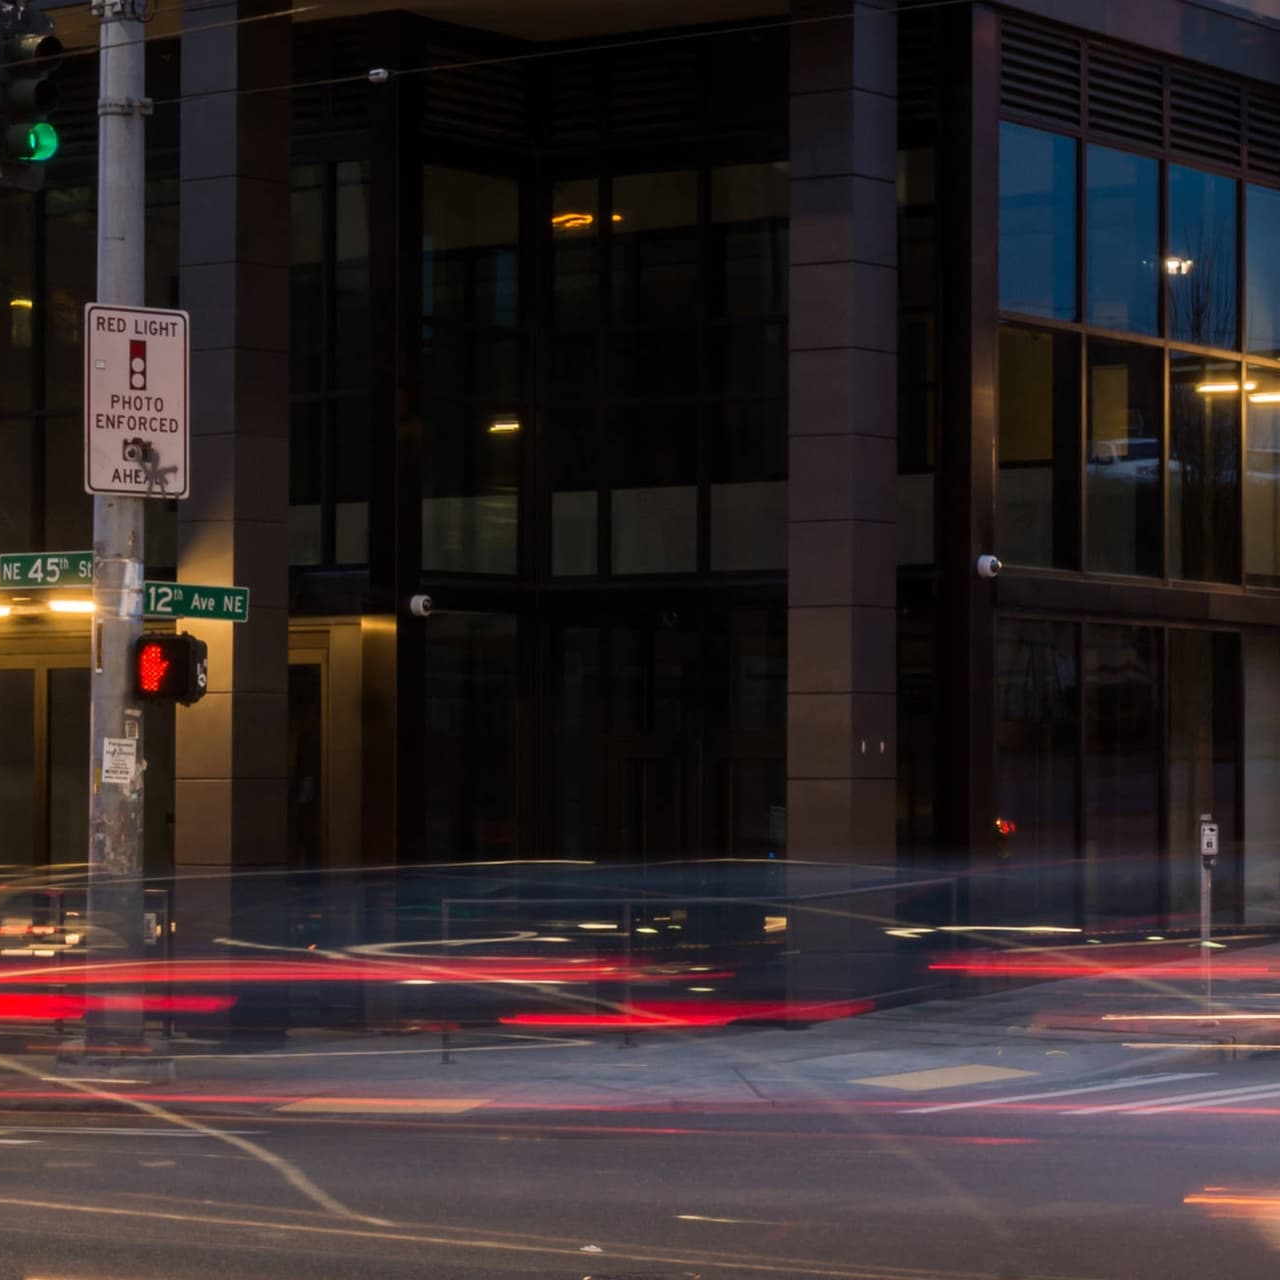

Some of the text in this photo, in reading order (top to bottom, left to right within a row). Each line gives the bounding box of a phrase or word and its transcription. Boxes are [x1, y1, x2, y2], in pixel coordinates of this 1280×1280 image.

[96, 316, 178, 337] RED LIGHT
[110, 394, 164, 413] PHOTO
[95, 413, 179, 434] ENFORCED
[2, 557, 93, 583] NE 45th St
[147, 586, 244, 614] 12th Ave NE
